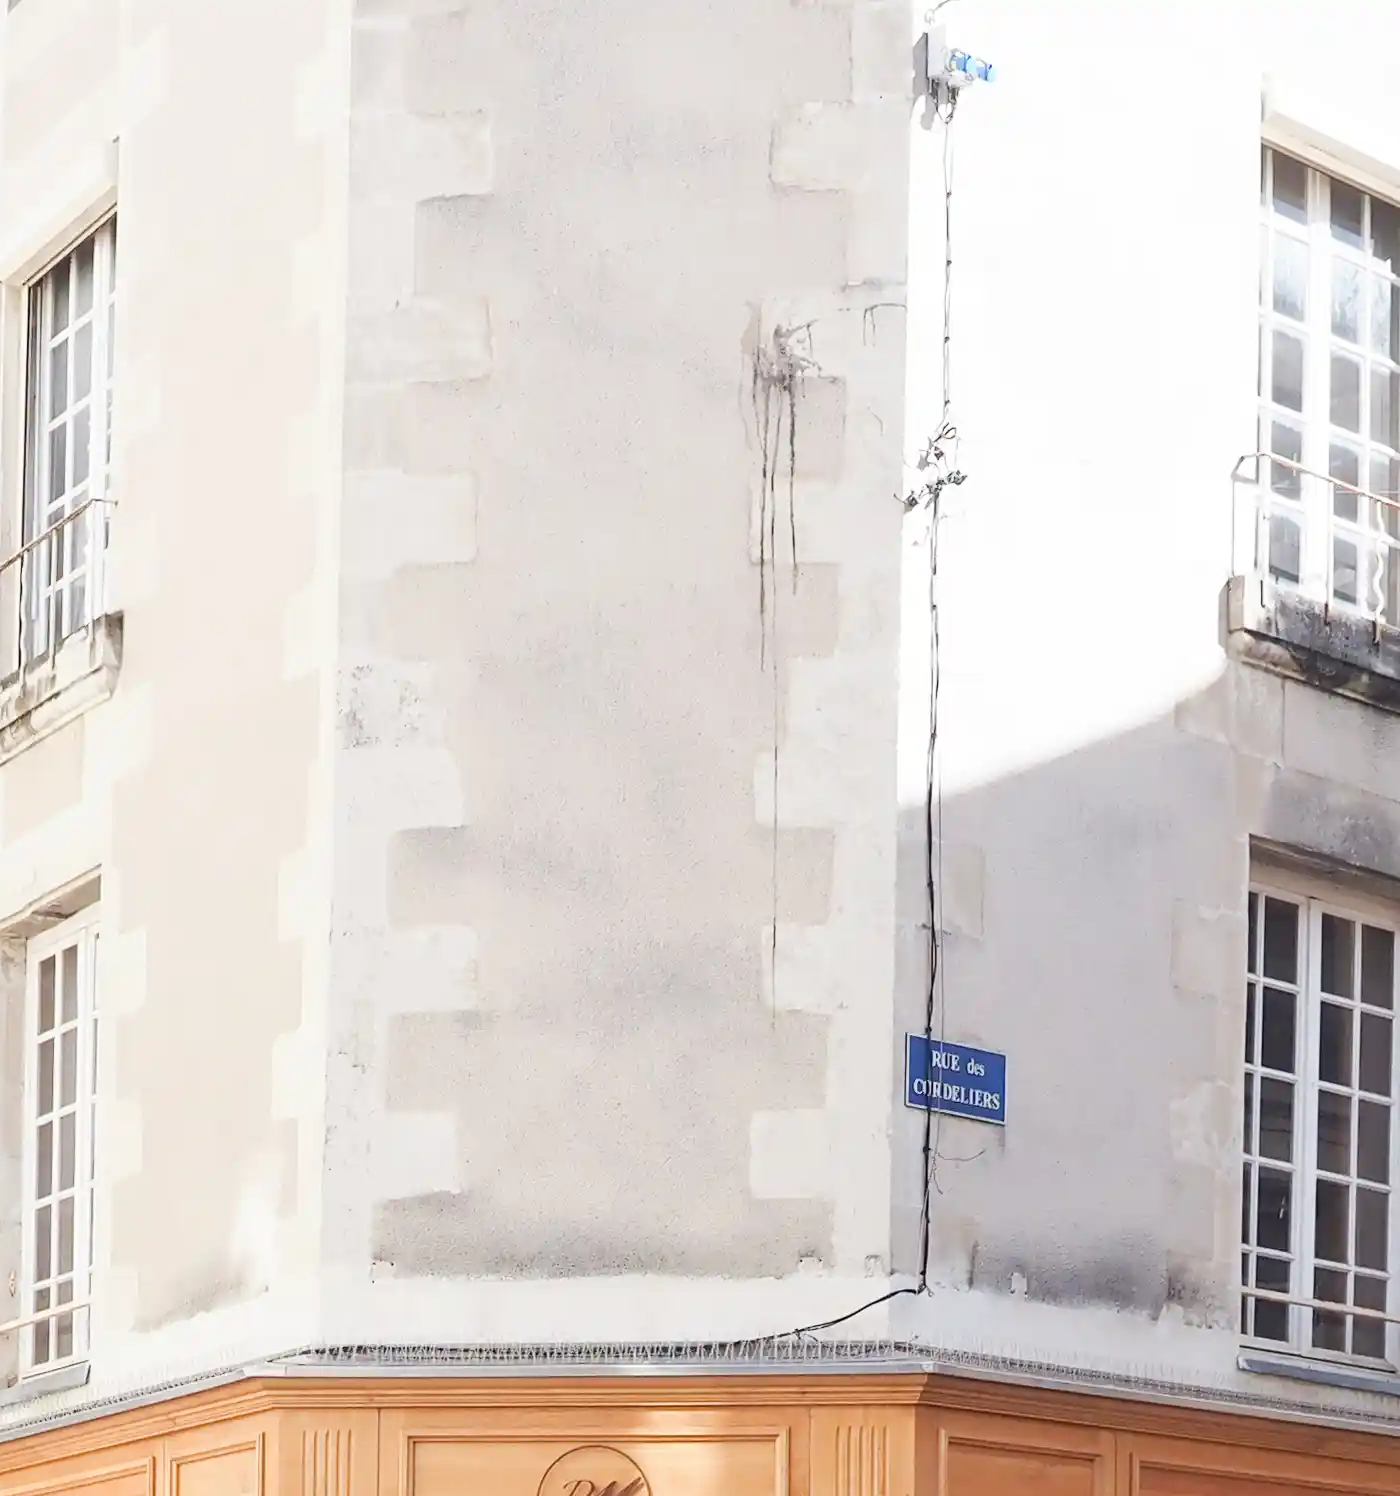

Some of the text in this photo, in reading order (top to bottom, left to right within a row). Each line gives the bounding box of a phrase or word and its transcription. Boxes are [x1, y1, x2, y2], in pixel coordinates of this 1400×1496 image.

[931, 1050, 985, 1077] RUE des
[913, 1078, 1000, 1110] CORDELIERS
